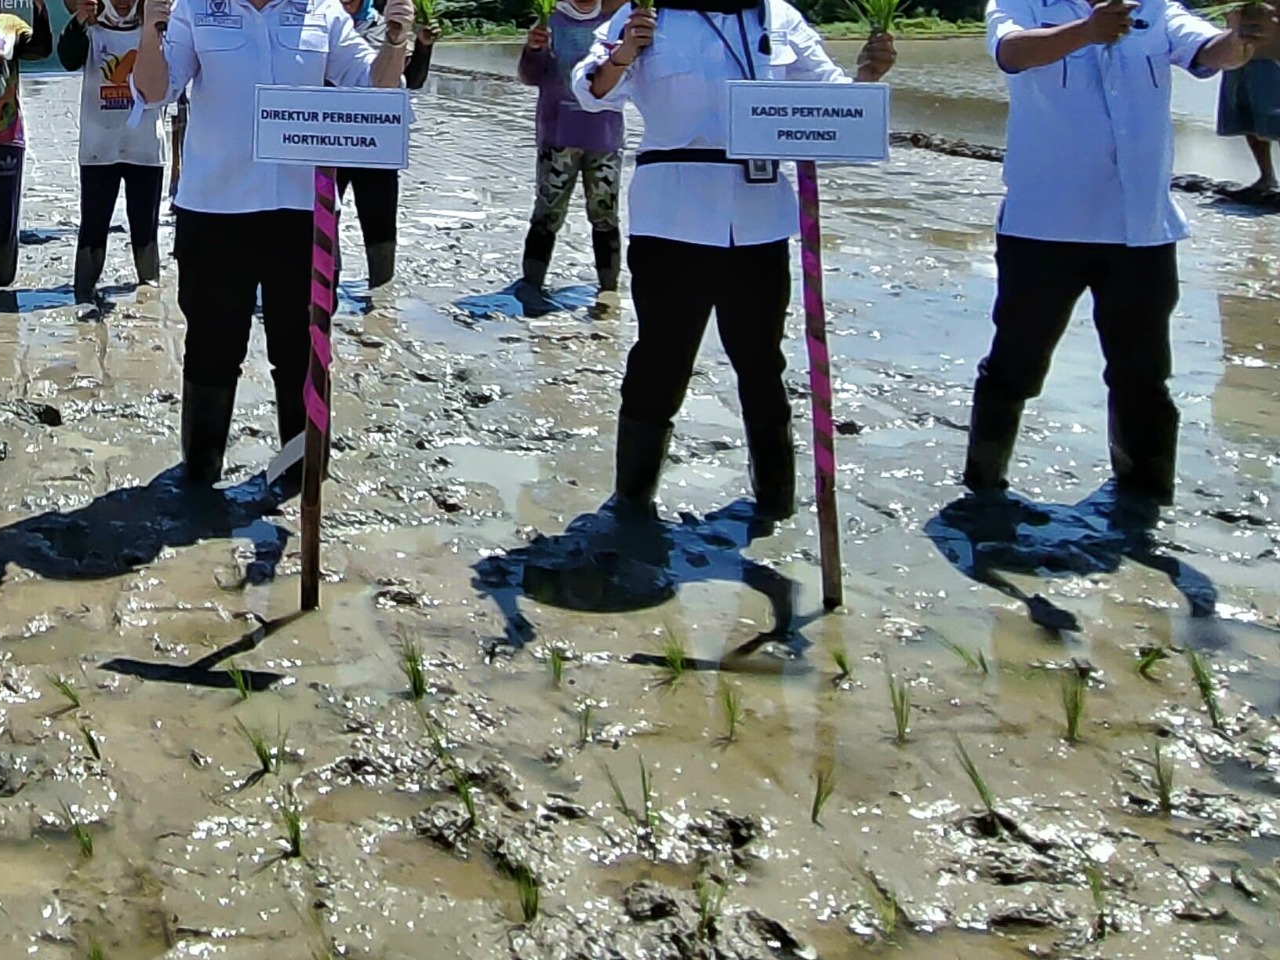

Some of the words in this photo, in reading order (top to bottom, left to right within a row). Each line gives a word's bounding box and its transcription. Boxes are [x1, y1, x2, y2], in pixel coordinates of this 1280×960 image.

[260, 109, 319, 122] DIREKTUR
[322, 112, 401, 124] PERBENIHAN
[751, 105, 789, 118] KADIS
[791, 106, 864, 119] PERTANIAN
[282, 133, 377, 147] HORTIKULTURA
[777, 129, 837, 141] PROVINSI
